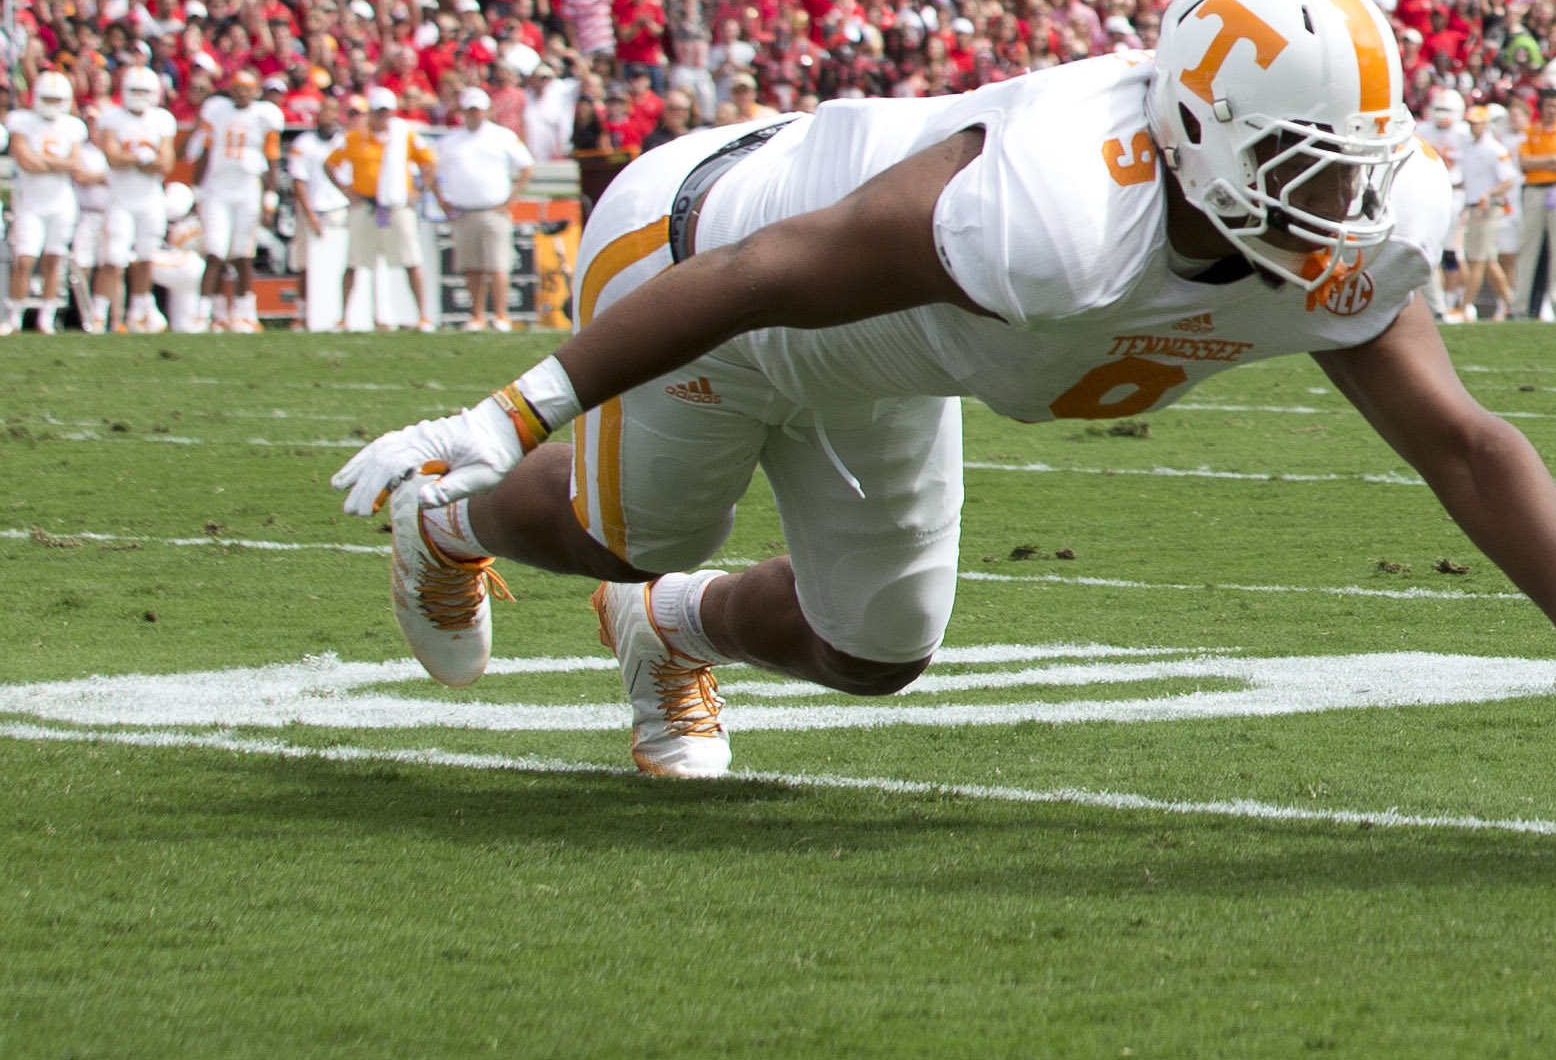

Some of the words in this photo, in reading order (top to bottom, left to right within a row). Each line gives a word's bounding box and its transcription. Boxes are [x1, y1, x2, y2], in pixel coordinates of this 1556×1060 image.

[1374, 116, 1391, 135] T
[1107, 335, 1254, 362] TENNESSEE
[664, 386, 722, 405] adidas
